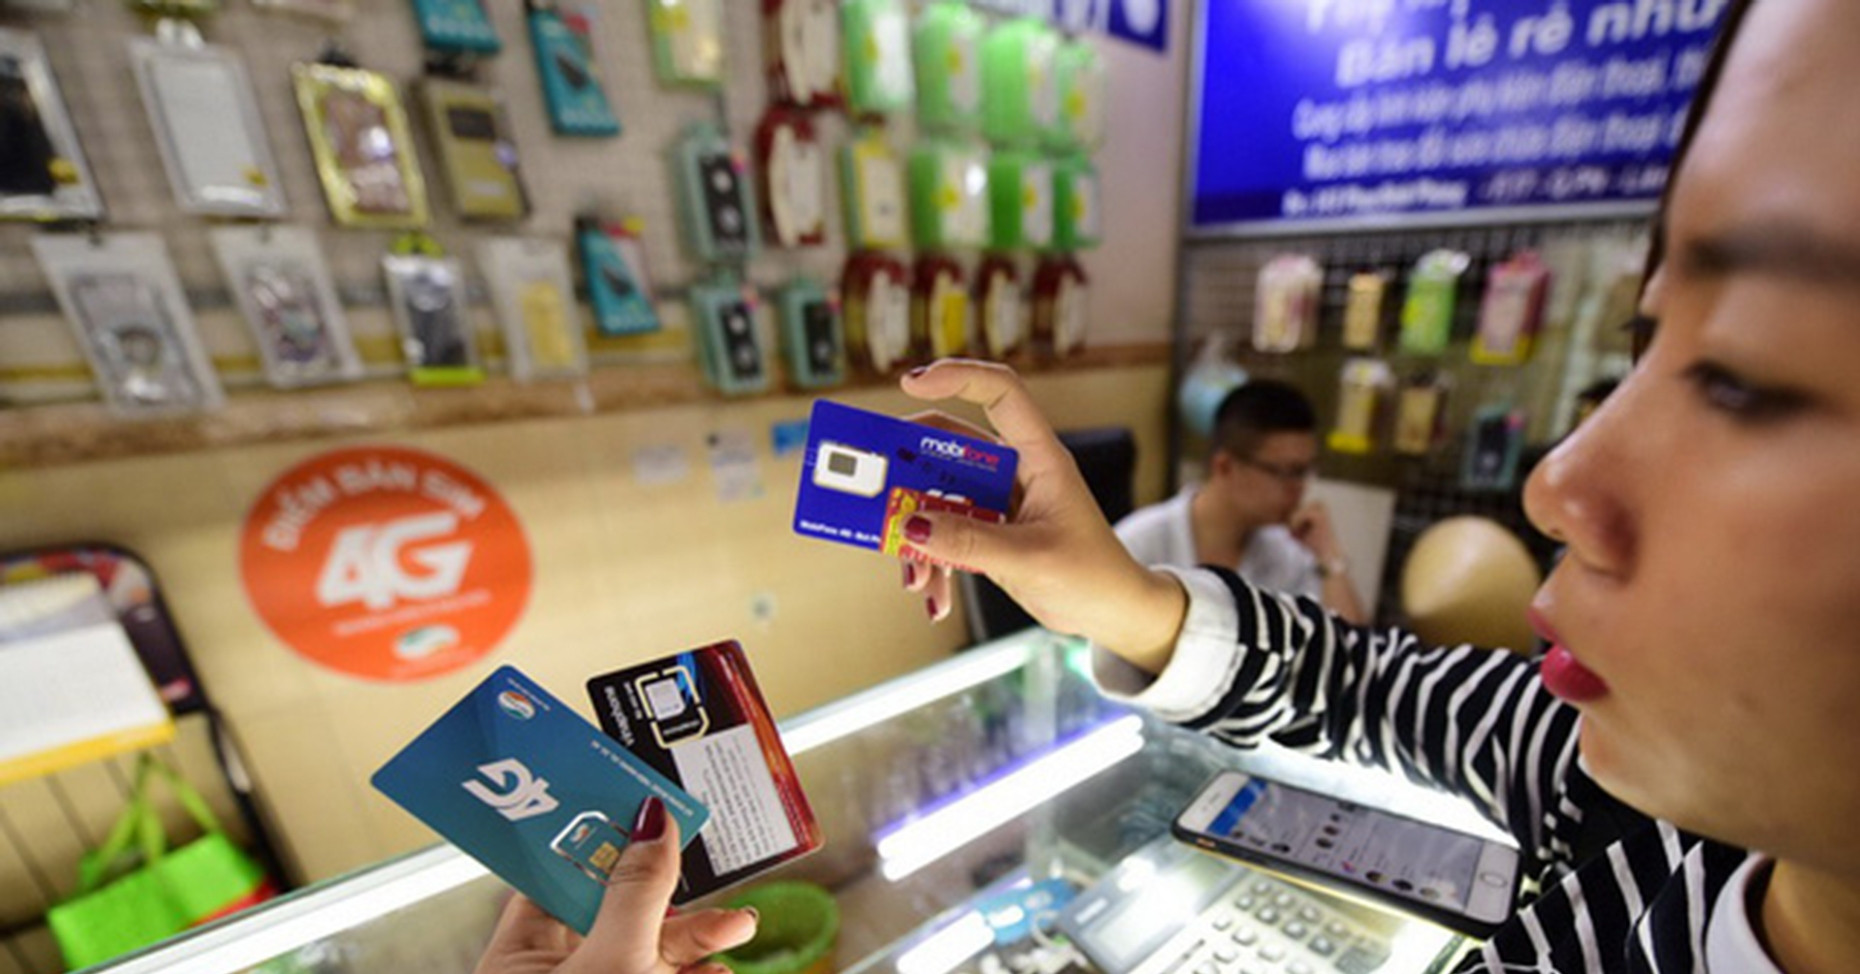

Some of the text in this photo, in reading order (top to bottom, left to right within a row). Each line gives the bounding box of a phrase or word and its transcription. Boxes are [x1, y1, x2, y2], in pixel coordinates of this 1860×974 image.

[920, 436, 1000, 467] mobifone
[315, 510, 474, 609] 4G
[461, 757, 560, 822] 4G
